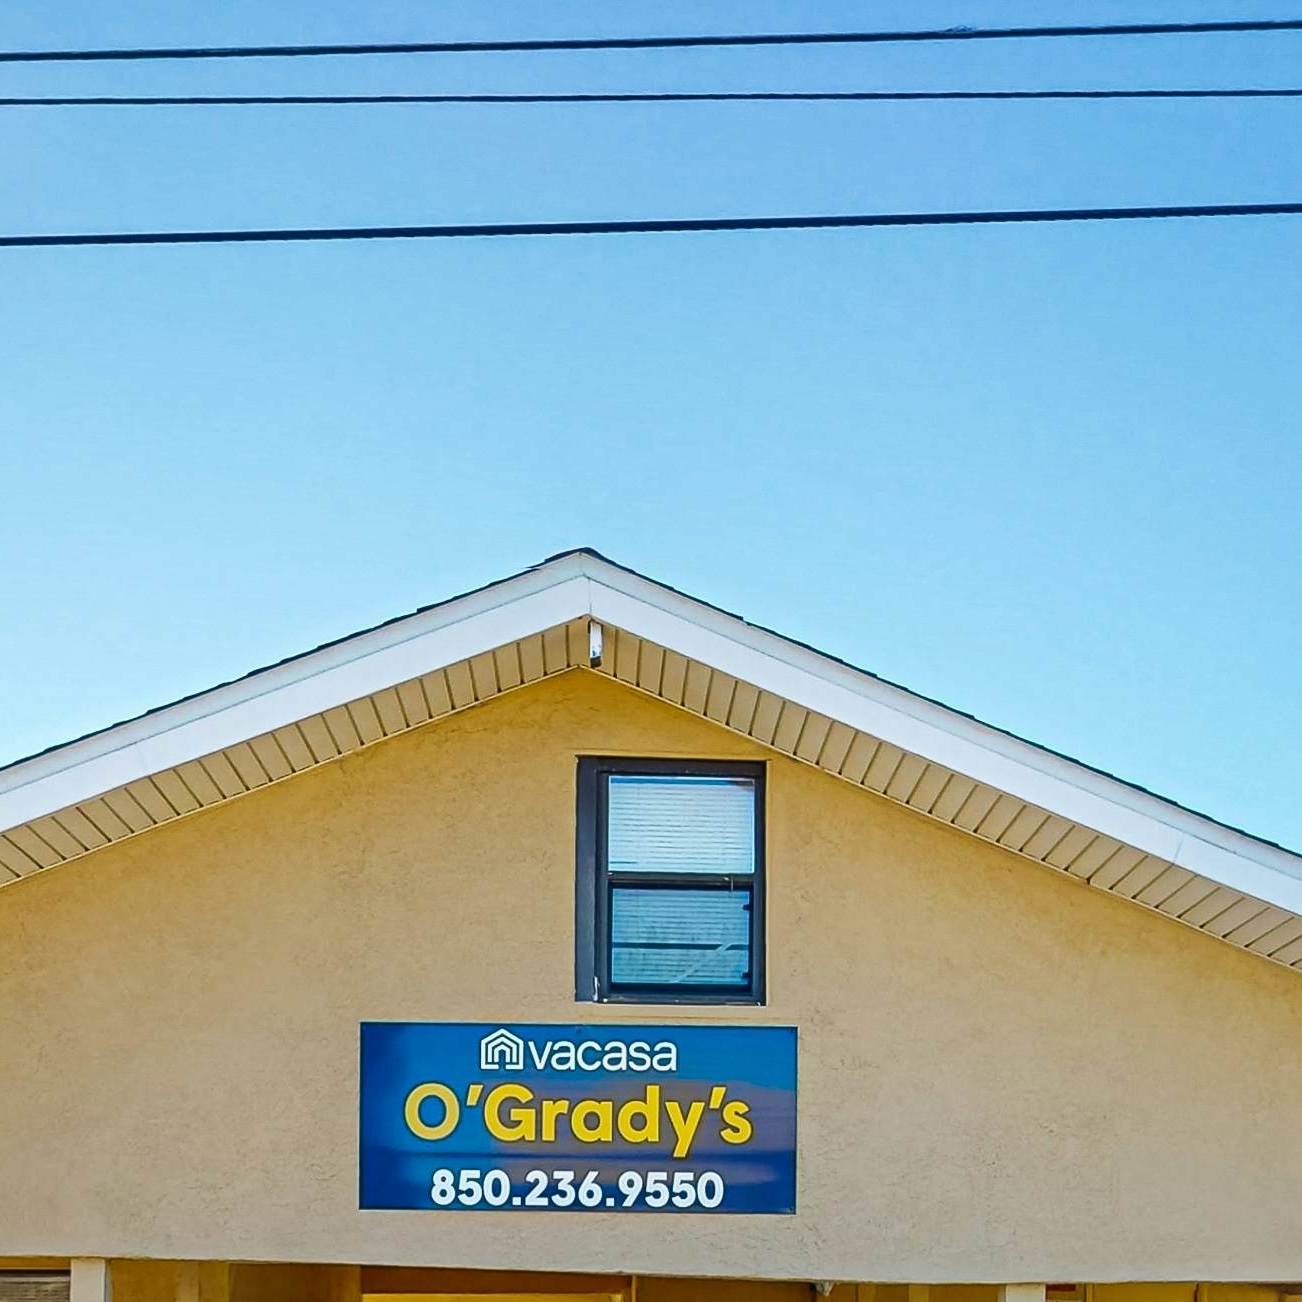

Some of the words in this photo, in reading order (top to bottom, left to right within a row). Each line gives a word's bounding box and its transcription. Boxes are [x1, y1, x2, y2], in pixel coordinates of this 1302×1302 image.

[528, 1040, 677, 1072] vacasa
[404, 1082, 753, 1158] O'Grady's
[431, 1168, 725, 1209] 850.236.9550
